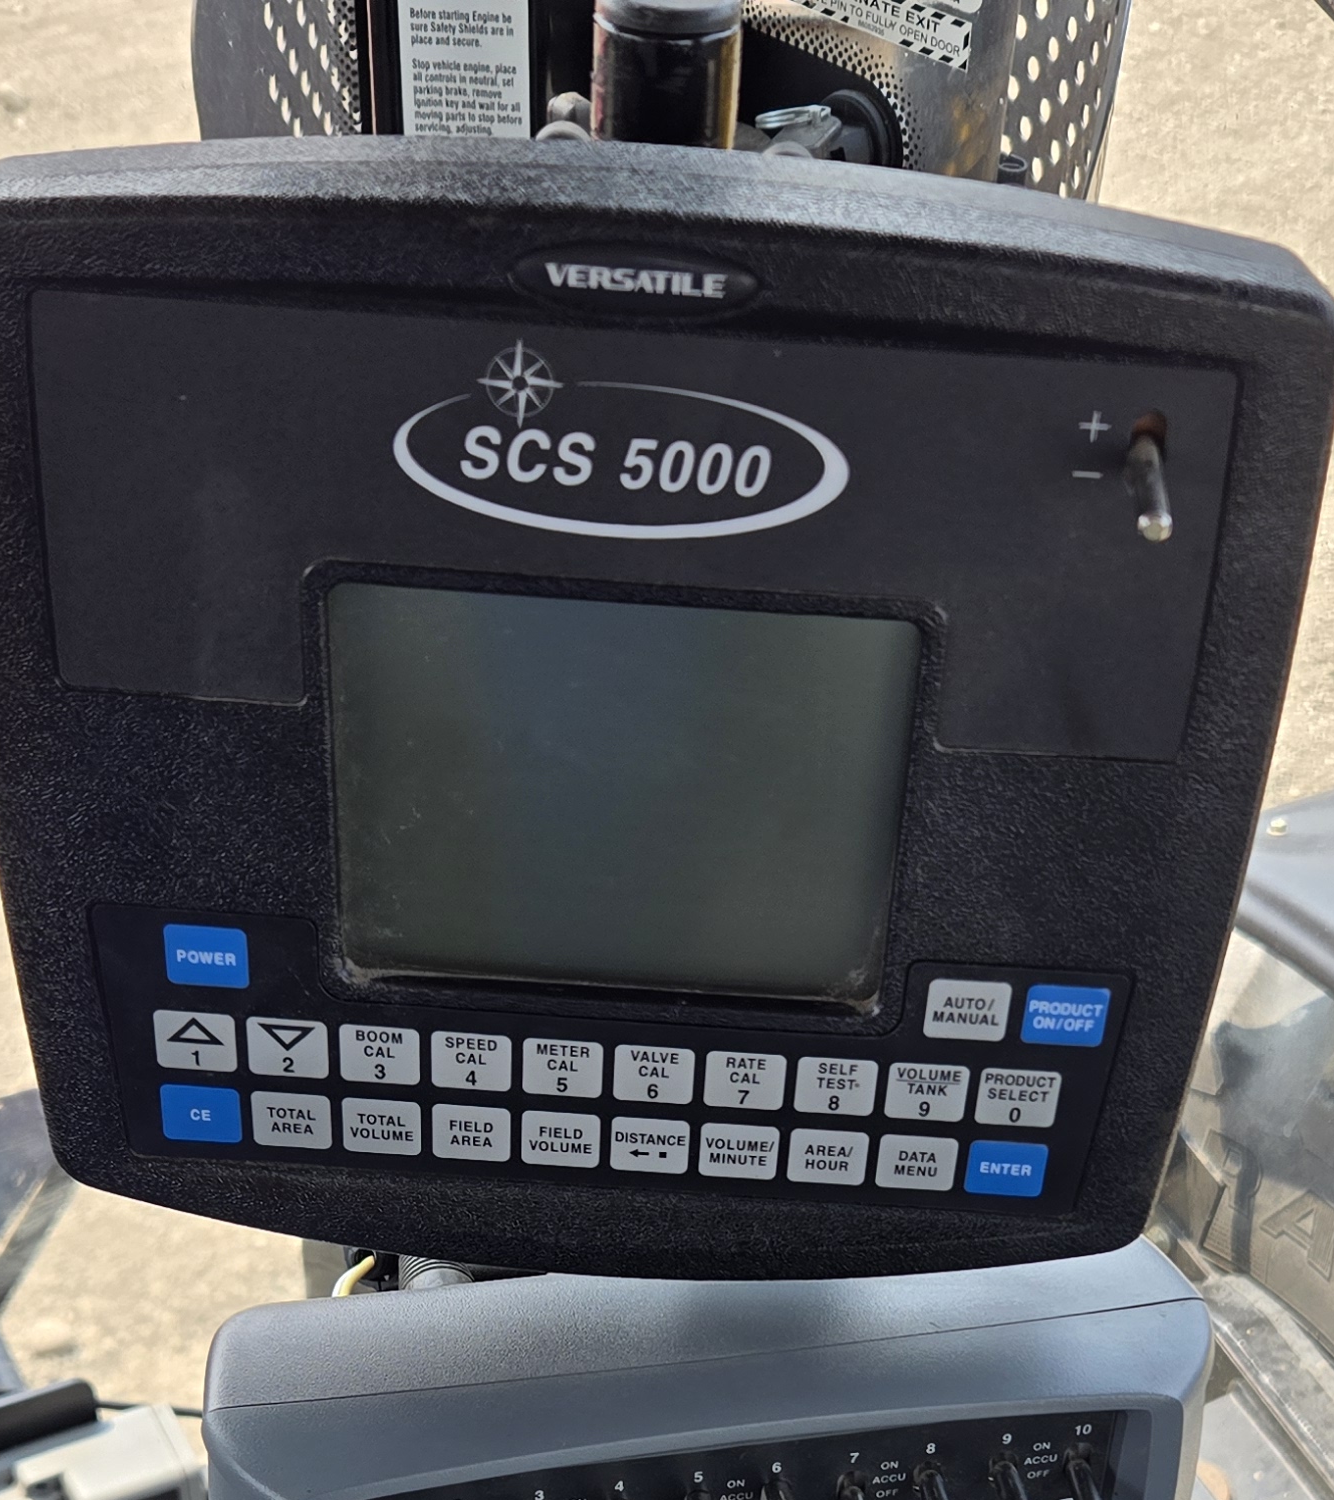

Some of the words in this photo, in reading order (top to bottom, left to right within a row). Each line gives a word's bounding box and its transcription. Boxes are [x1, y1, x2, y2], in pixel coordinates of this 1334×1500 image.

[410, 8, 436, 20] Before
[439, 10, 469, 23] starting
[473, 10, 499, 24] Engine
[502, 12, 512, 24] be
[905, 11, 940, 33] EXIT
[411, 22, 428, 32] sure
[431, 22, 456, 35] Safety
[459, 23, 488, 35] Shields
[506, 26, 514, 36] in
[850, 4, 863, 18] TO
[866, 10, 897, 31] FULLY
[899, 24, 927, 44] OPEN
[930, 36, 960, 57] DOOR
[411, 34, 432, 47] place
[435, 36, 449, 46] and
[412, 58, 430, 71] Stop
[433, 60, 460, 71] vehicle
[495, 62, 516, 75] place
[425, 72, 456, 83] controls
[459, 74, 466, 84] in
[413, 85, 443, 97] parking
[472, 88, 502, 99] remove
[445, 98, 459, 110] key
[462, 100, 476, 110] and
[511, 102, 520, 112] all
[415, 110, 443, 122] moving
[478, 113, 495, 124] stop
[497, 114, 522, 125] before
[544, 262, 727, 299] VERSATILE
[459, 425, 597, 487] SCS
[619, 438, 773, 499] 5000
[176, 949, 236, 967] POWER
[943, 996, 995, 1012] AUTO/
[1029, 1000, 1103, 1019] PRODUCT
[933, 1010, 1000, 1027] MANUAL
[1032, 1015, 1095, 1033] ON/OFF
[355, 1031, 403, 1045] BOOM
[445, 1036, 498, 1051] SPEED
[191, 1050, 201, 1066] 1
[363, 1044, 396, 1059] CAL
[455, 1051, 487, 1066] CAL
[536, 1044, 591, 1059] METER
[631, 1050, 680, 1065] VALVE
[282, 1057, 294, 1073] 2
[374, 1064, 387, 1080] 3
[547, 1058, 579, 1073] CAL
[726, 1057, 766, 1072] RATE
[818, 1063, 858, 1077] SELF
[465, 1070, 478, 1086] 4
[638, 1065, 670, 1080] CAL
[730, 1070, 761, 1085] CAL
[897, 1068, 962, 1083] VOLUME
[556, 1077, 568, 1093] 5
[817, 1076, 856, 1091] TEST
[985, 1073, 1056, 1089] PRODUCT
[647, 1083, 659, 1099] 6
[907, 1082, 948, 1097] TANK
[987, 1087, 1050, 1103] SELECT
[737, 1090, 750, 1106] 7
[828, 1095, 840, 1111] 8
[190, 1108, 211, 1123] CE
[267, 1106, 316, 1122] TOTAL
[918, 1102, 930, 1118] 9
[1009, 1107, 1020, 1123] 0
[270, 1120, 314, 1136] AREA
[356, 1113, 406, 1129] TOTAL
[449, 1119, 494, 1135] FIELD
[350, 1127, 414, 1143] VOLUME
[450, 1132, 493, 1148] AREA
[539, 1126, 584, 1141] FIELD
[615, 1131, 686, 1148] DISTANCE
[529, 1139, 593, 1156] VOLUME
[706, 1137, 775, 1153] VOLUME/
[805, 1143, 853, 1158] AREA/
[709, 1151, 768, 1167] MINUTE
[805, 1157, 849, 1172] HOUR
[899, 1150, 937, 1164] DATA
[894, 1162, 938, 1178] MENU
[979, 1162, 1032, 1177] ENTER
[1074, 1424, 1092, 1436] 10
[1002, 1433, 1012, 1445] 9
[1033, 1442, 1051, 1451] ON
[926, 1443, 936, 1454] 8
[850, 1453, 859, 1463] 7
[881, 1460, 899, 1470] ON
[1024, 1454, 1058, 1466] ACCU
[772, 1462, 782, 1473] 6
[1027, 1469, 1050, 1479] OFF
[694, 1472, 703, 1483] 5
[727, 1479, 745, 1489] ON
[872, 1472, 907, 1484] ACCU
[614, 1481, 624, 1491] 4
[876, 1488, 899, 1499] OFF
[535, 1490, 544, 1500] 3
